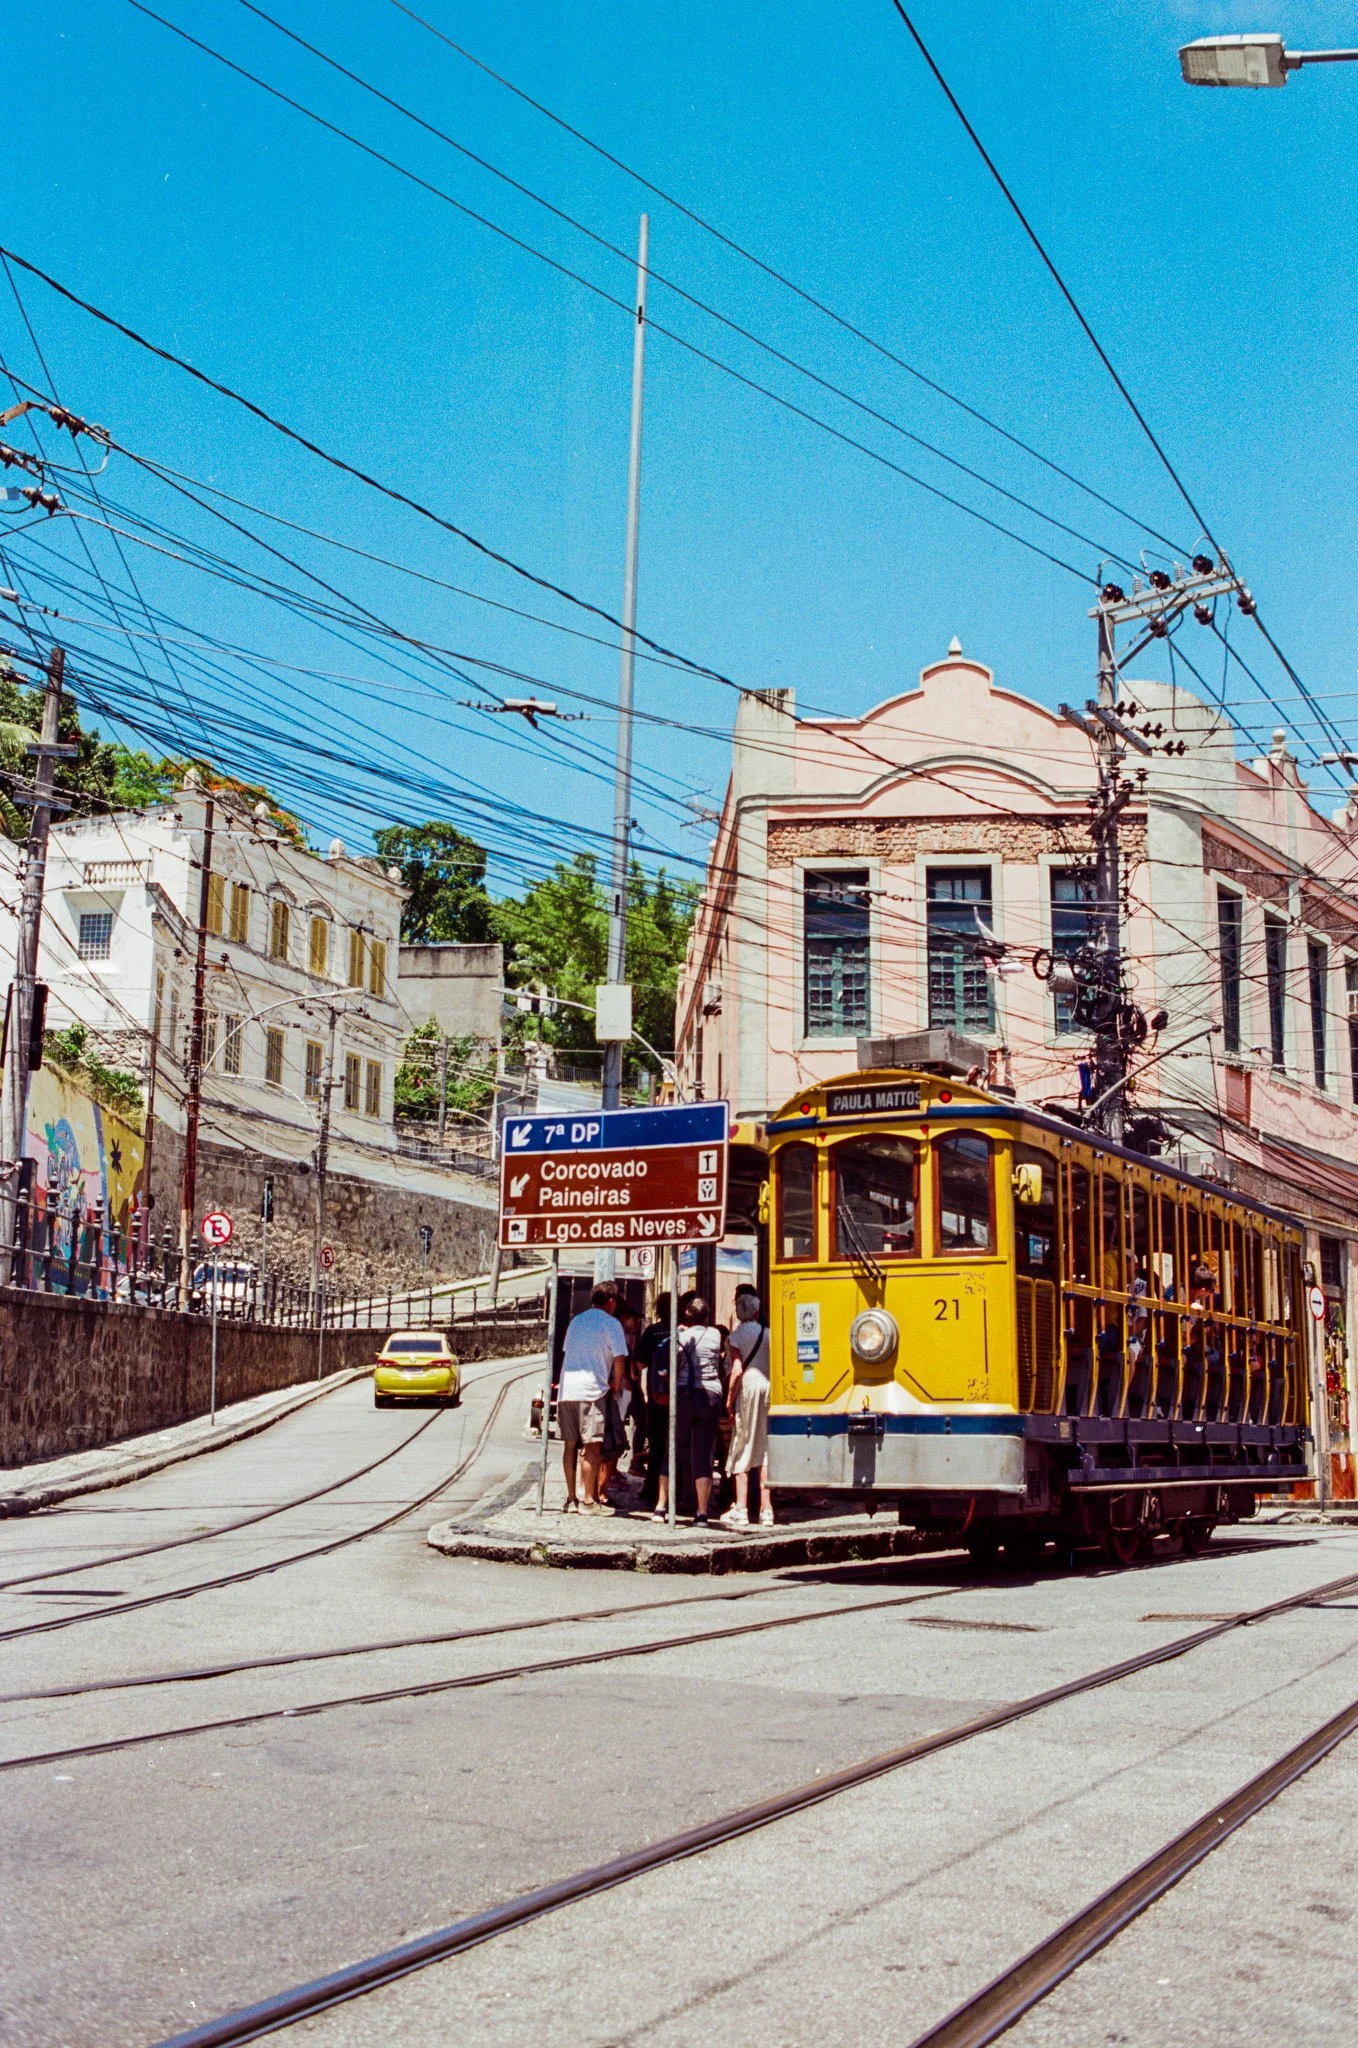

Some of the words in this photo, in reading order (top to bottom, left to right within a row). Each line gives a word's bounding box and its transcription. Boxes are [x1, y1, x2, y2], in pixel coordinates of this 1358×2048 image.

[833, 1094, 872, 1110] PAULA
[875, 1091, 921, 1108] MATTOS
[544, 1123, 565, 1144] 7ª
[572, 1122, 600, 1143] DP
[540, 1160, 647, 1180] Corcovado
[539, 1187, 630, 1207] Paineiras
[212, 1219, 223, 1237] E
[545, 1220, 587, 1243] Lgo.
[590, 1219, 625, 1238] das
[630, 1217, 686, 1236] Neves
[934, 1299, 959, 1321] 21
